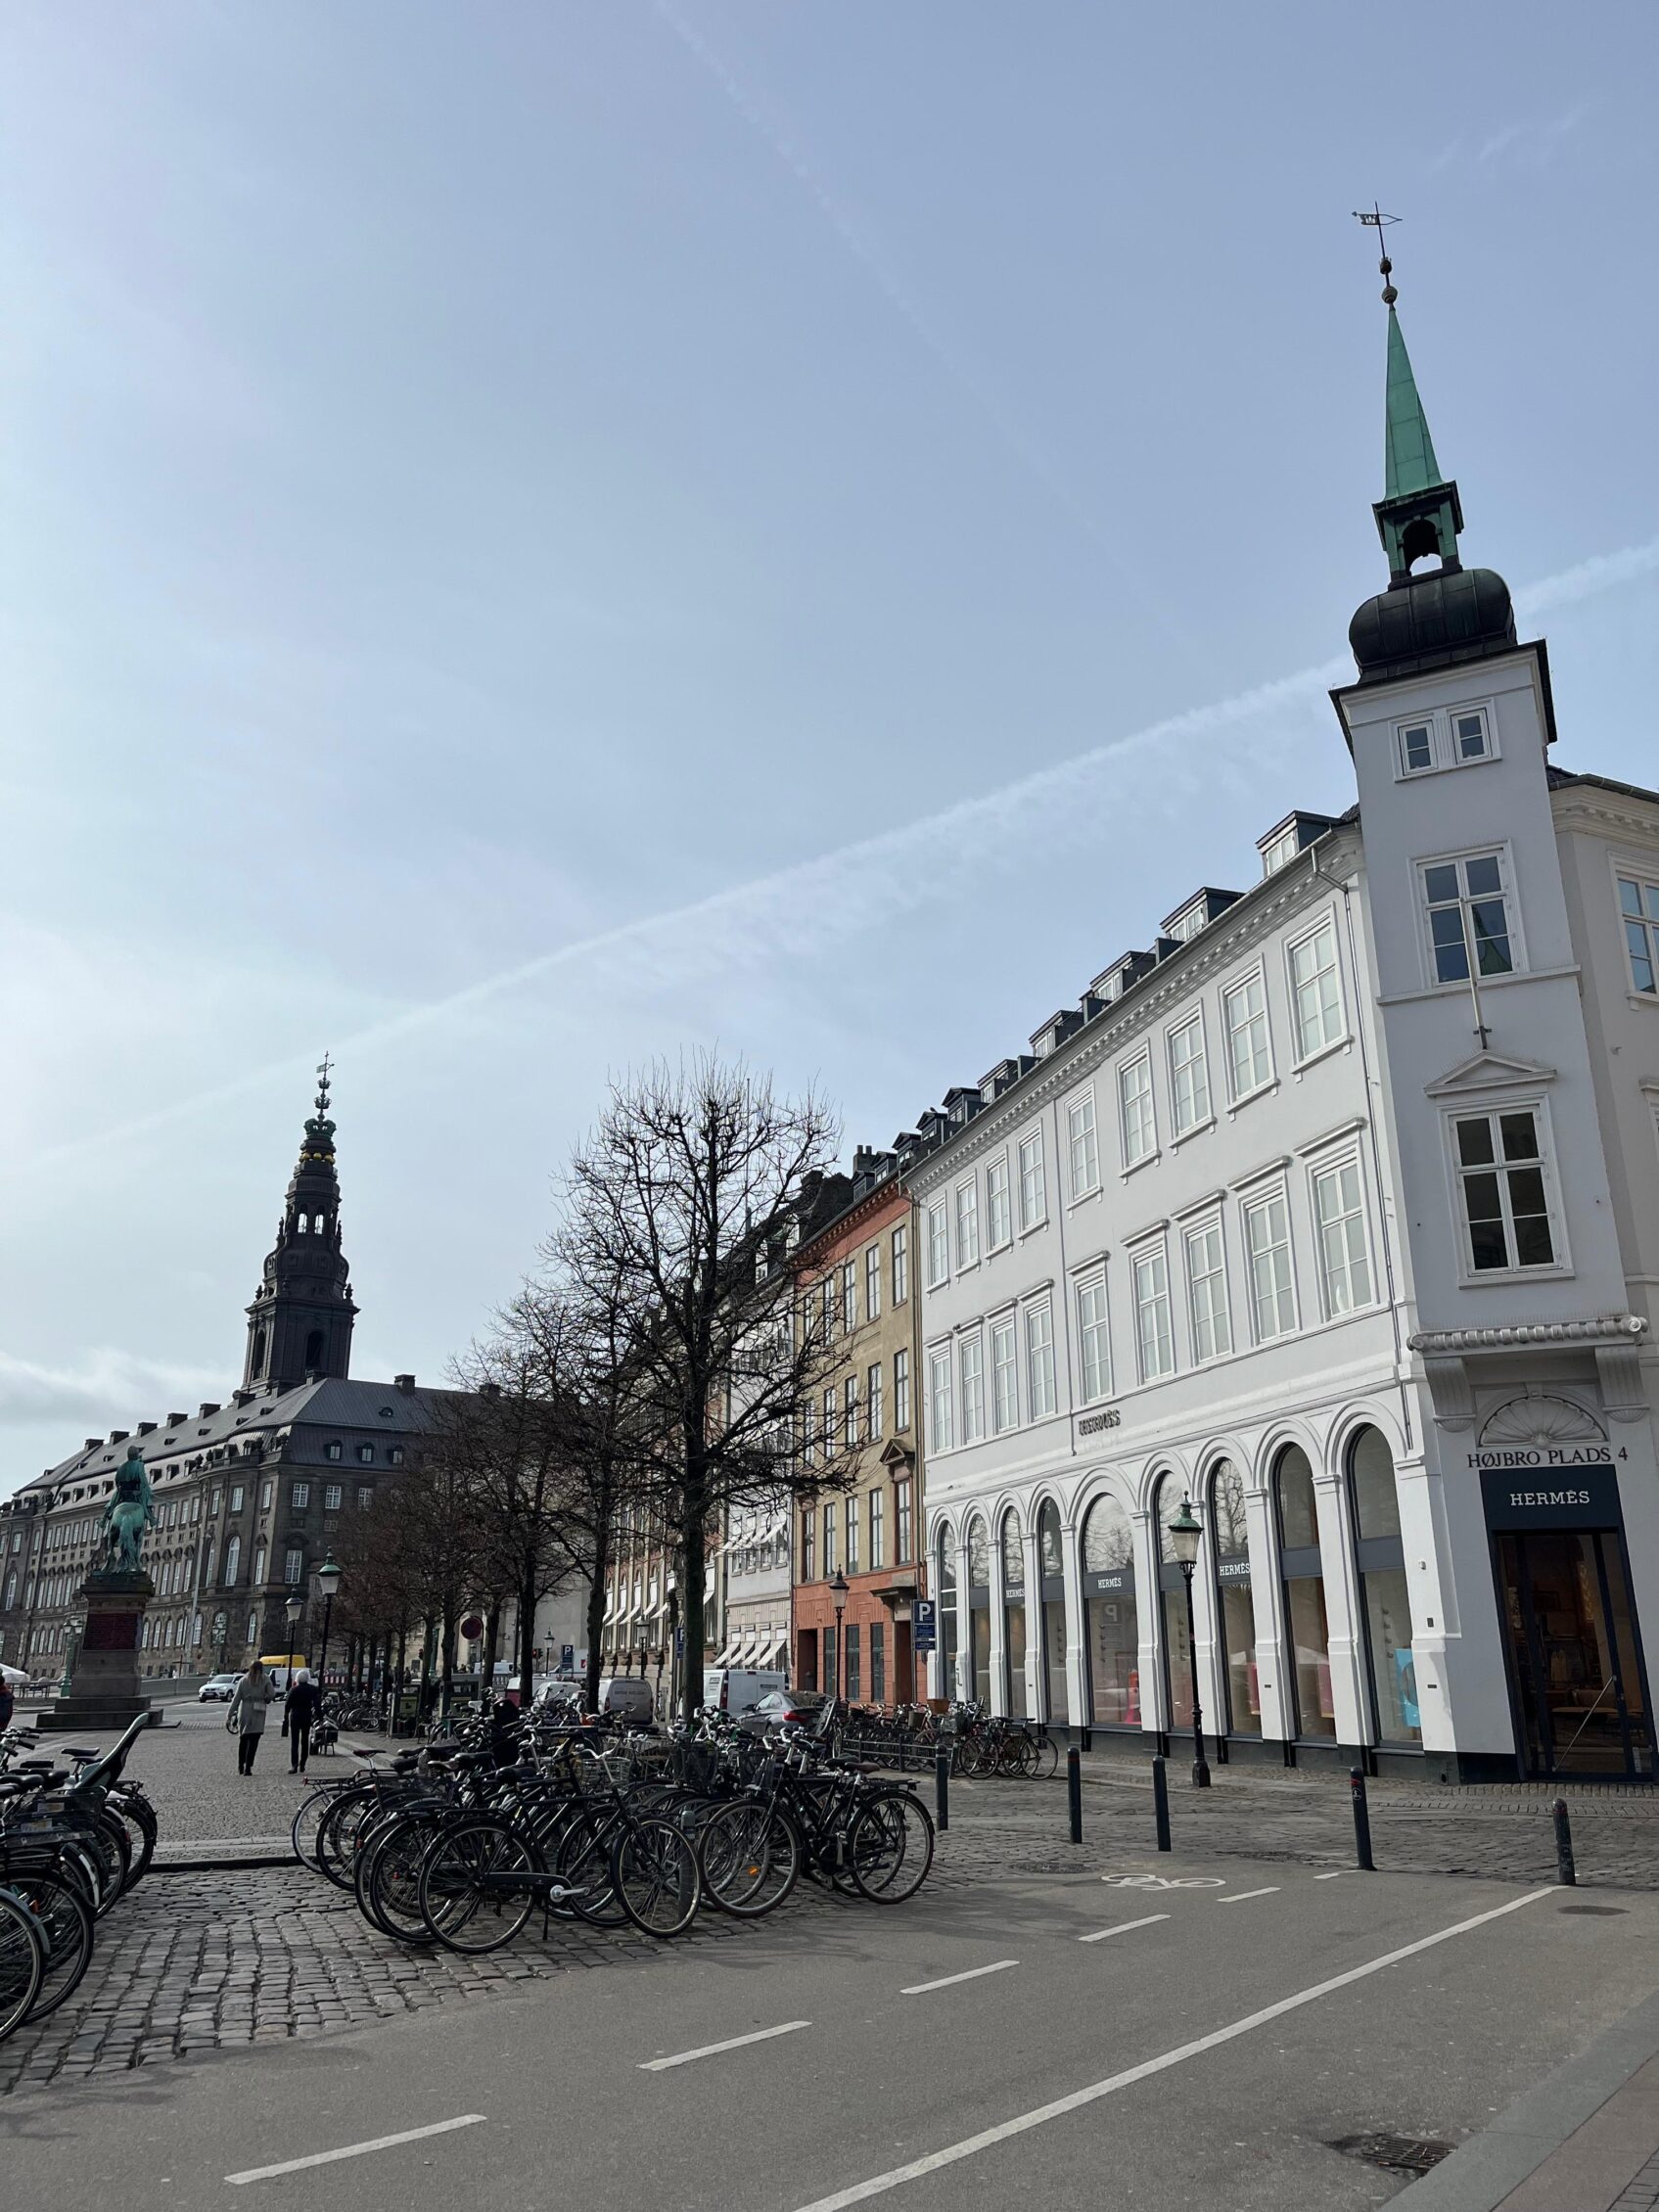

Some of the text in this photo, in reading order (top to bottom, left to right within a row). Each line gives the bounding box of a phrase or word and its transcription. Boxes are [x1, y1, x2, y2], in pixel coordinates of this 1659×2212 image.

[1467, 1447, 1628, 1468] HØJBRO PLADS 4
[1509, 1490, 1590, 1506] HERMÈS
[919, 1603, 931, 1622] P
[565, 1645, 572, 1655] P
